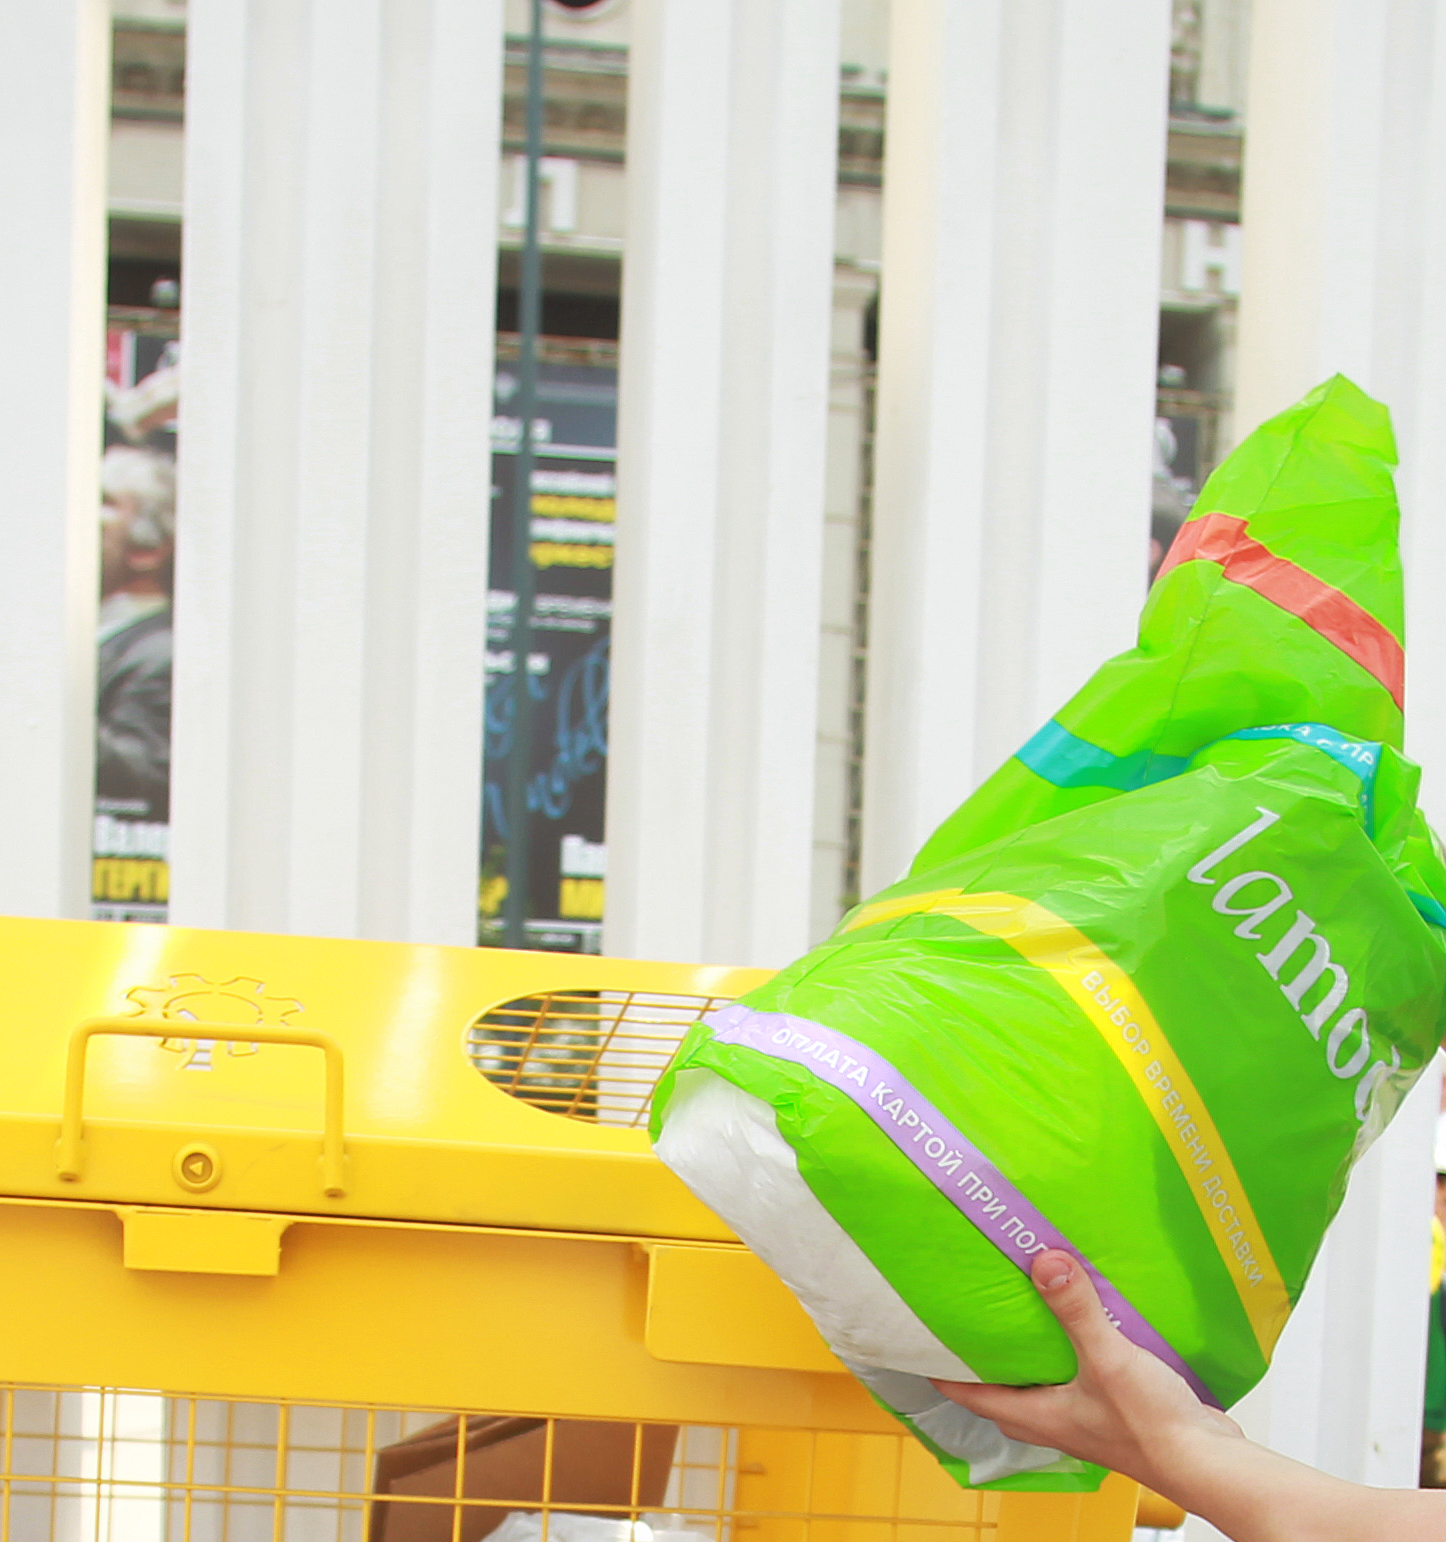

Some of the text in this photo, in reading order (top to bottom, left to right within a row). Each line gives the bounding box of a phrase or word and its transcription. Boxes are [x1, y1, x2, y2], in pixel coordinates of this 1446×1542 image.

[770, 1027, 870, 1088] ОПЛАТА
[870, 1081, 964, 1177] КАРТОЙ
[957, 1171, 1009, 1222] ПРИ
[1080, 969, 1265, 1288] ВЫБОР ВРЕМЕНИ ДОСТАВКИ
